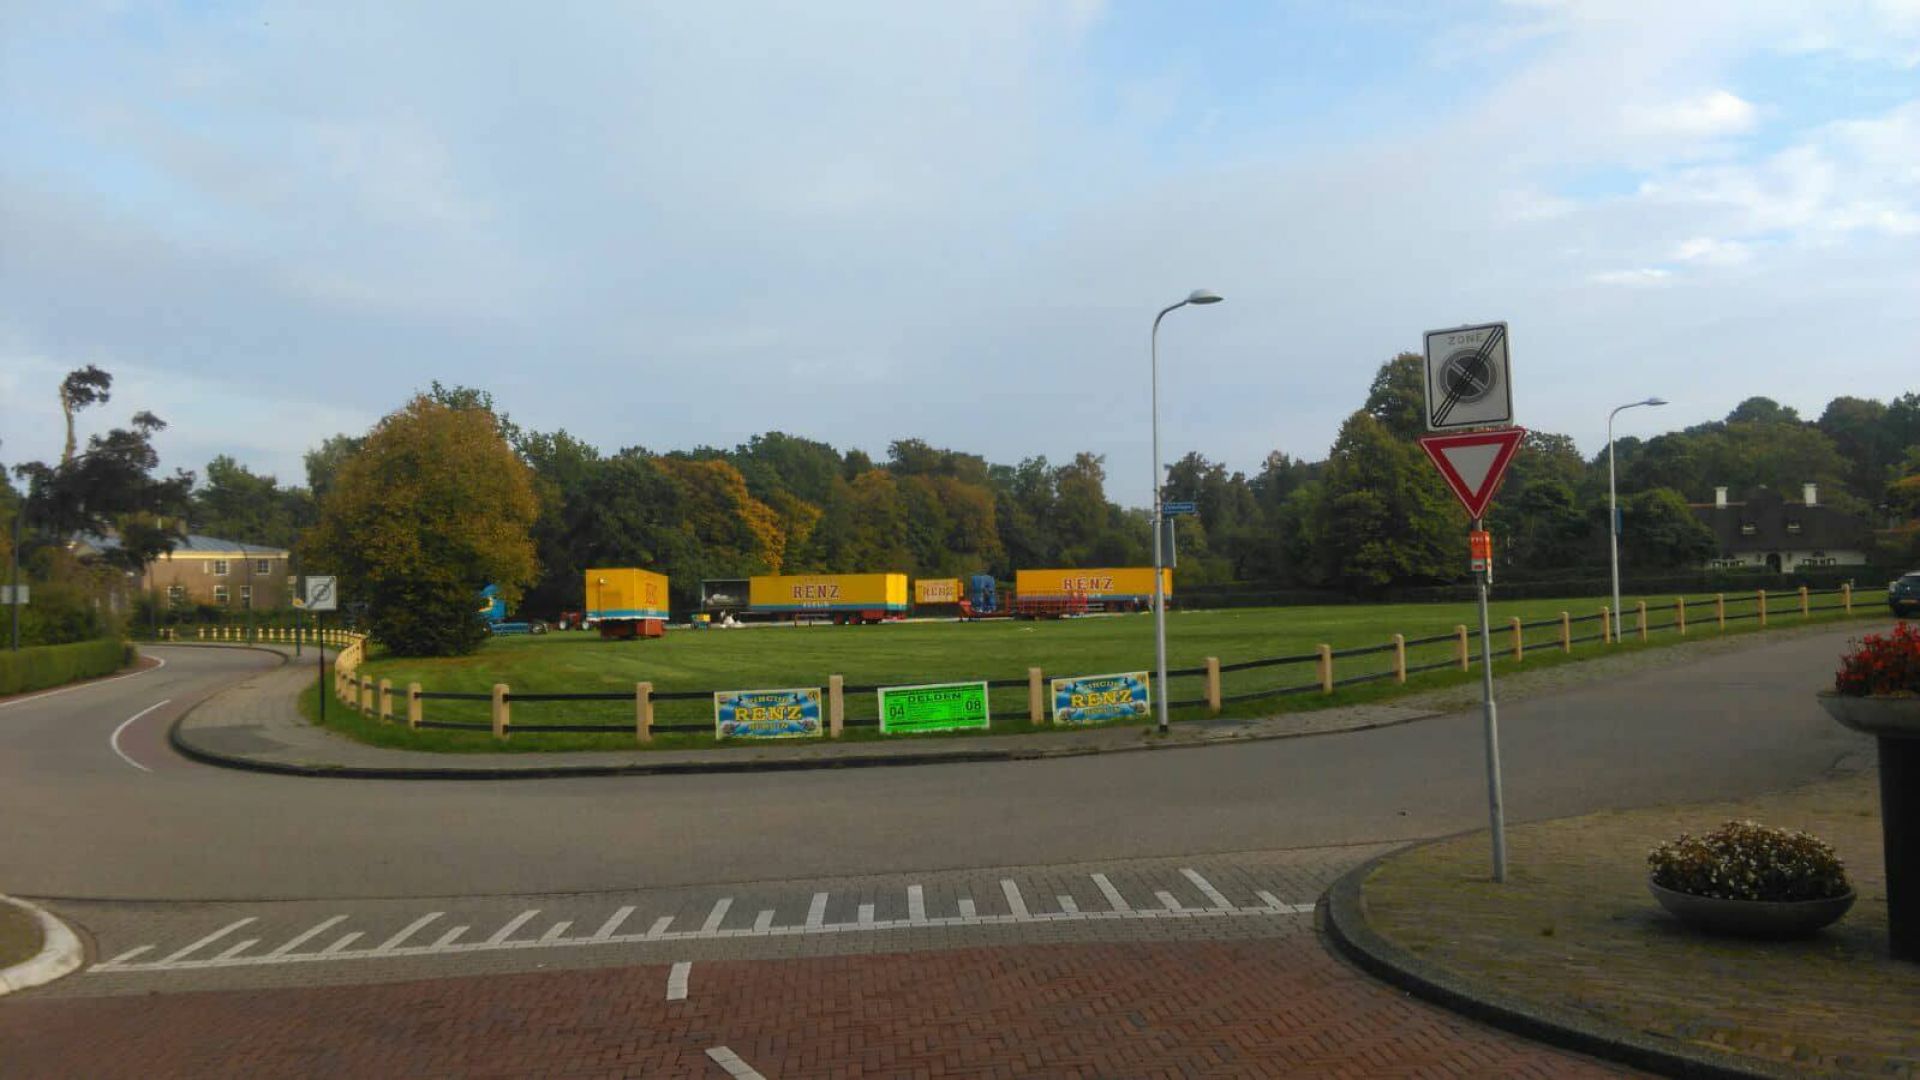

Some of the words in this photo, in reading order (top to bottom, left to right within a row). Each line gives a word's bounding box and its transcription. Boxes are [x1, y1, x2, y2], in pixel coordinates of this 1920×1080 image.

[1447, 332, 1484, 346] ZONE
[1063, 577, 1114, 590] RENZ
[792, 585, 840, 599] RENZ
[908, 692, 961, 703] DELDEN
[1070, 688, 1133, 708] RENZ
[889, 705, 905, 717] 04
[965, 700, 982, 711] 08
[734, 704, 802, 721] RENZ
